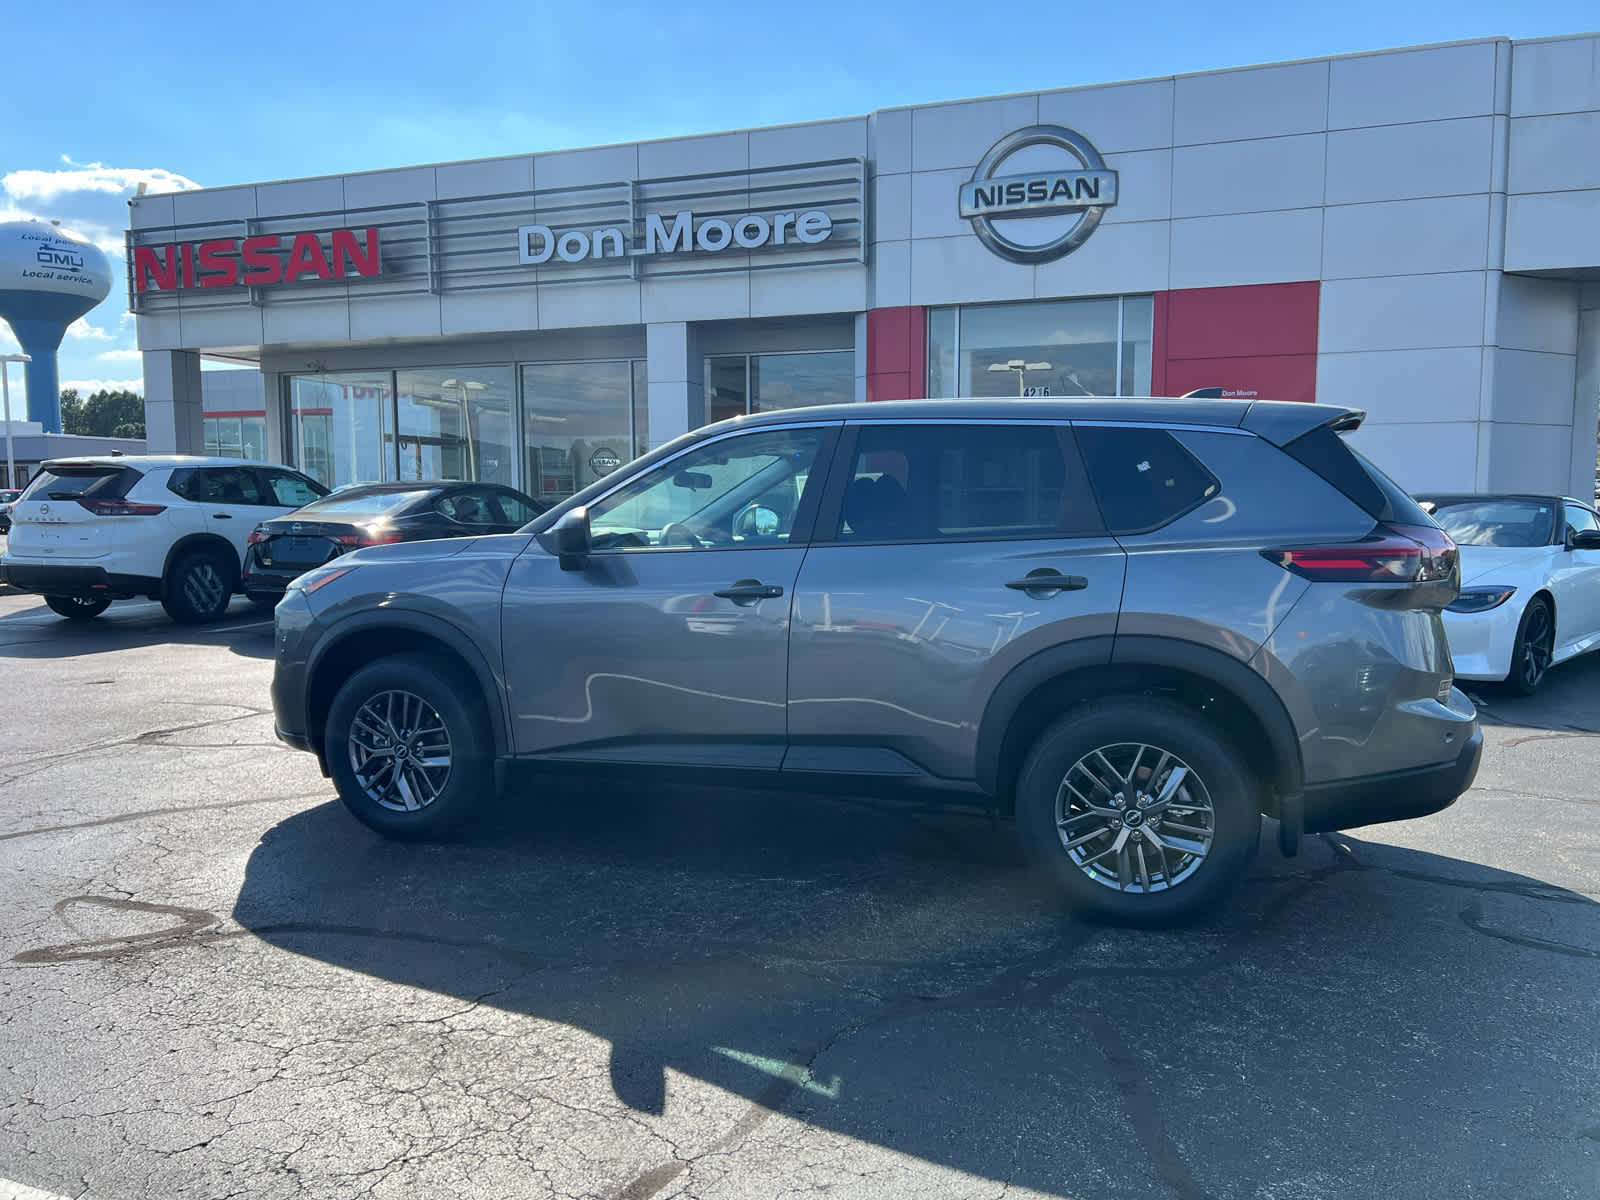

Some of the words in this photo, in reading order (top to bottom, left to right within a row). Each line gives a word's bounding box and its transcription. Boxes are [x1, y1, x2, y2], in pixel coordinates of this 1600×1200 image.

[974, 176, 1099, 208] NISSAN
[518, 224, 624, 265] Don
[645, 210, 832, 252] Moore
[22, 269, 54, 279] Local
[134, 228, 379, 292] NISSAN
